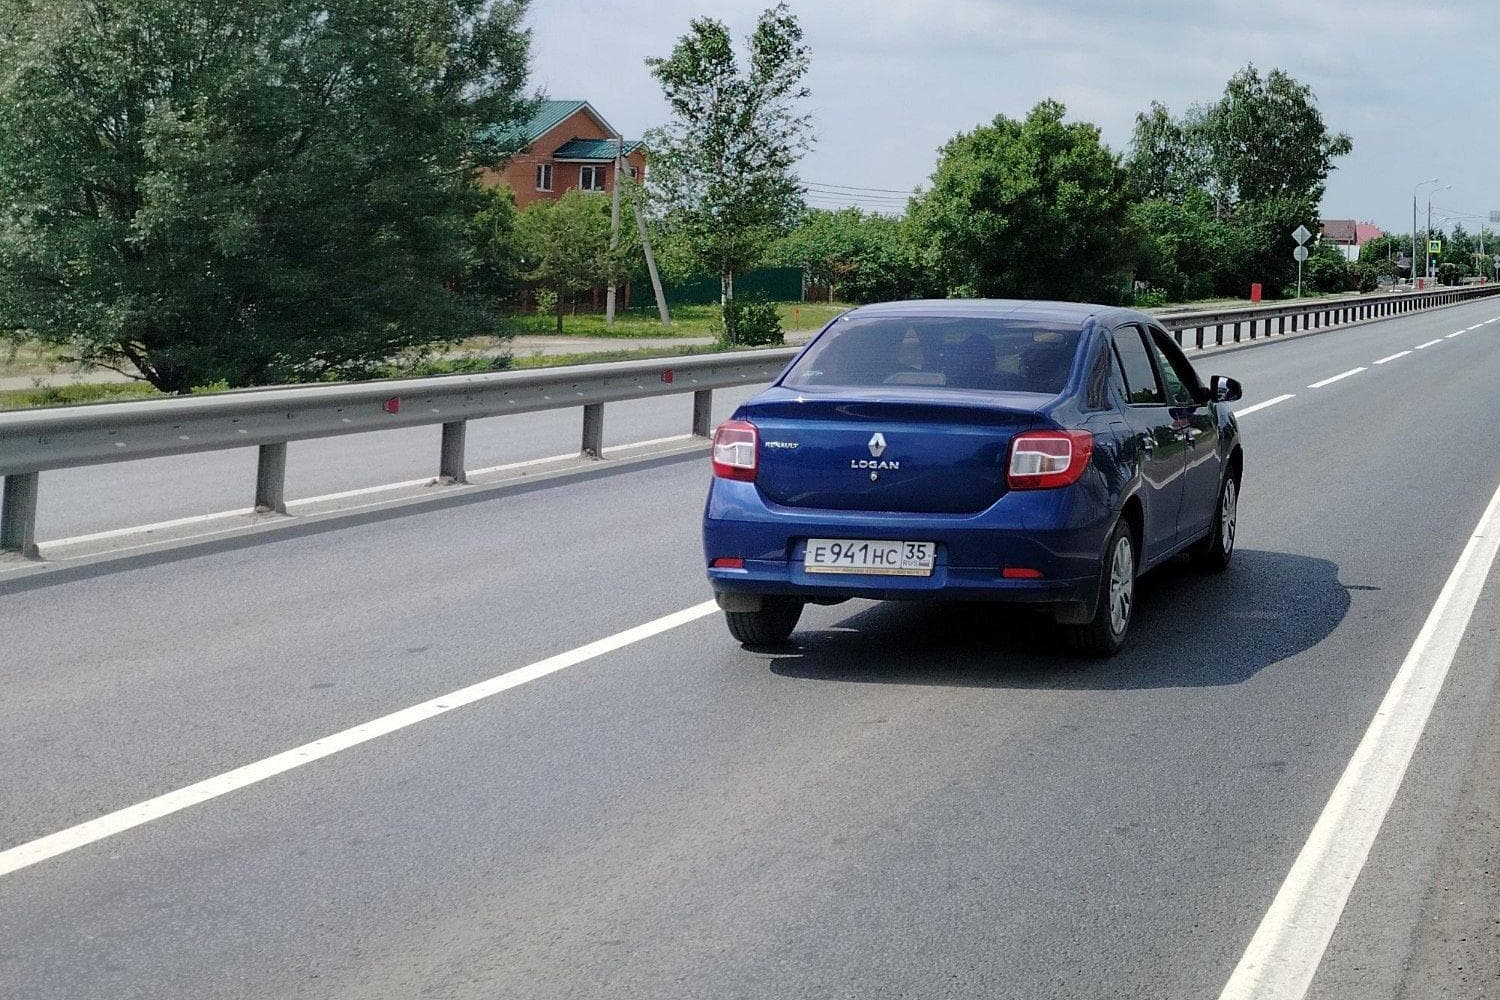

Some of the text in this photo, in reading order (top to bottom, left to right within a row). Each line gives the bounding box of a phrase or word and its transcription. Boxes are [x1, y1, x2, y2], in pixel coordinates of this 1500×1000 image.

[765, 441, 799, 449] RENAULT
[851, 459, 900, 470] LOGAN
[814, 543, 927, 565] Е941НС 35
